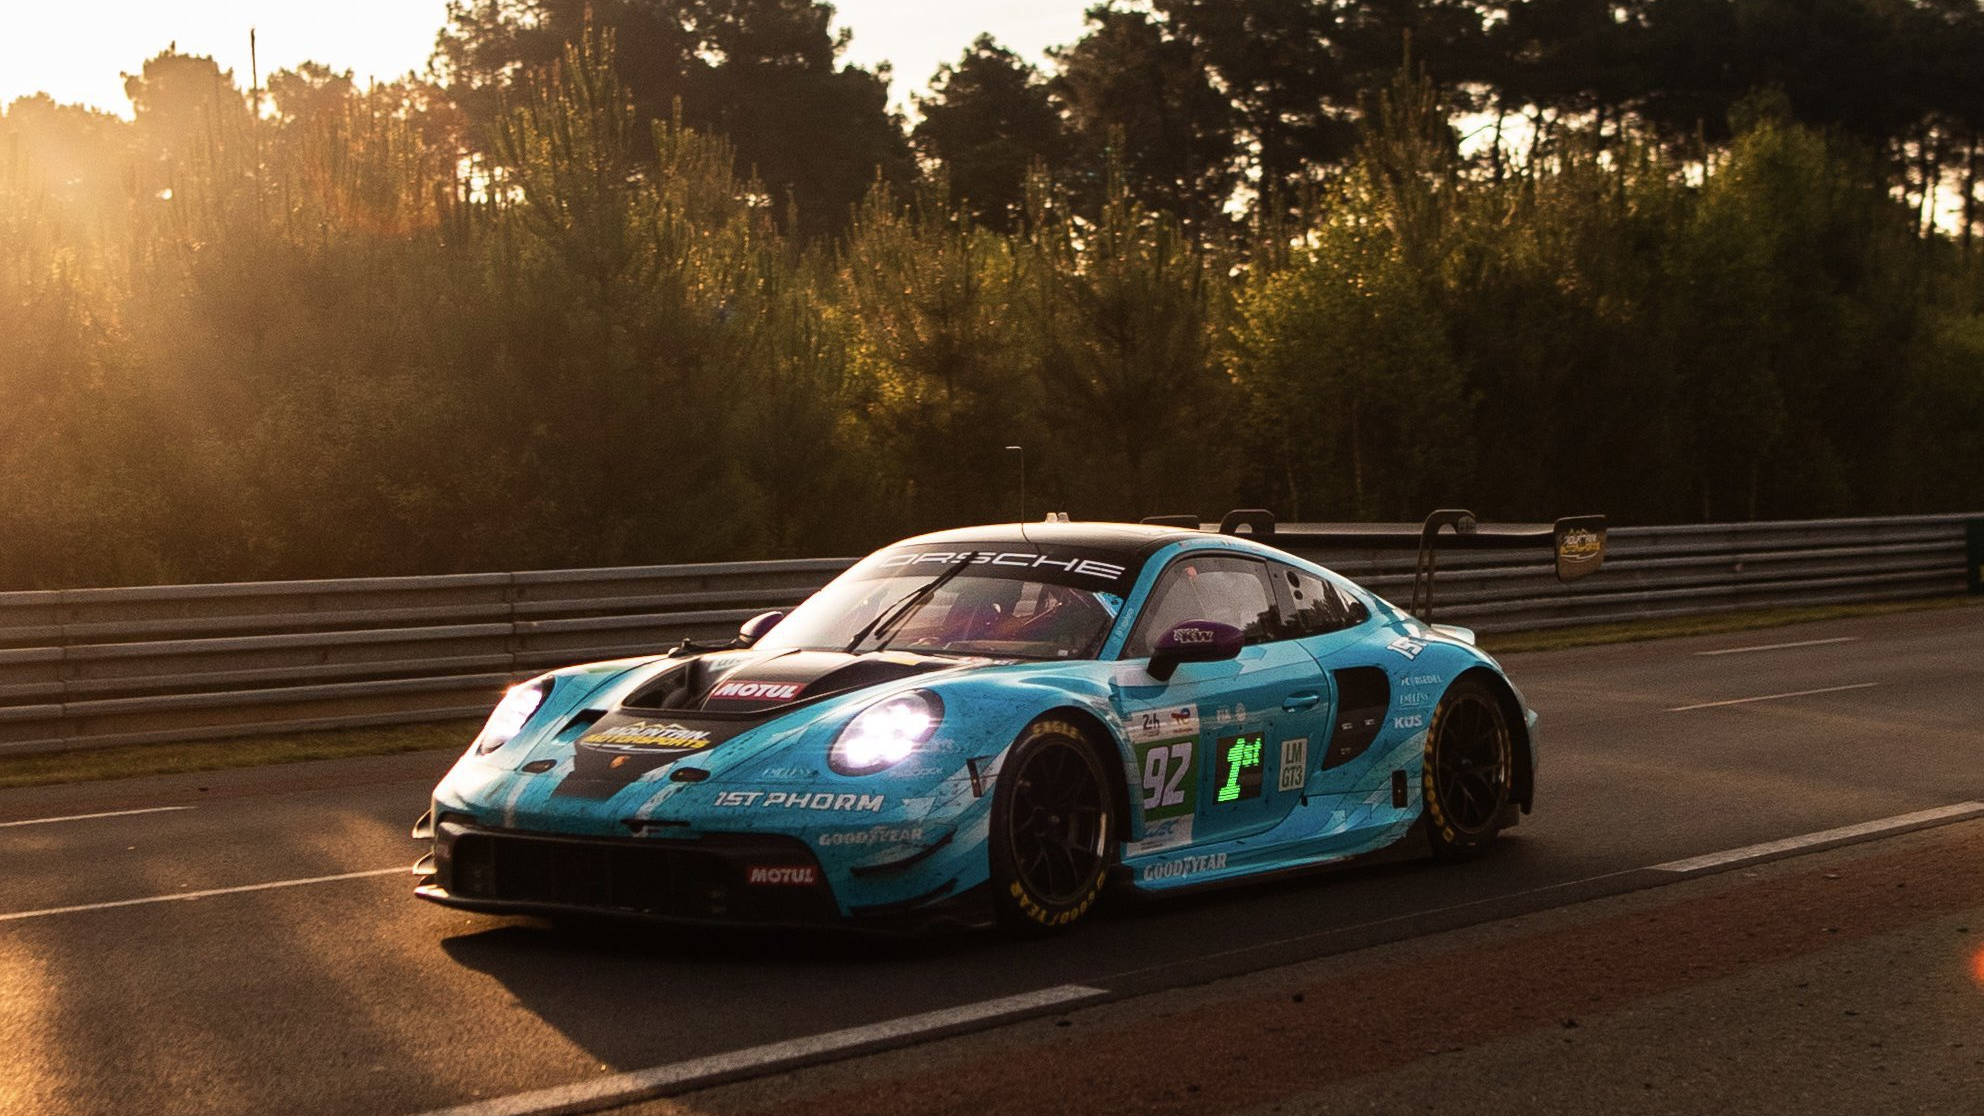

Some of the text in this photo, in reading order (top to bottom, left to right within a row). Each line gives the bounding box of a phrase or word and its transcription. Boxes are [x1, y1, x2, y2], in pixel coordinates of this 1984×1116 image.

[715, 683, 798, 698] MOTUL
[584, 734, 712, 749] MOTORSPORTS
[601, 726, 712, 740] MOUNTAIN
[1285, 741, 1303, 764] LM
[1143, 741, 1193, 810] 92
[1282, 765, 1303, 788] GT3
[714, 791, 885, 812] 1ST PHORM
[819, 825, 923, 846] GOODYEAR
[750, 868, 814, 883] MOTUL
[1143, 853, 1228, 881] GOODYEAR
